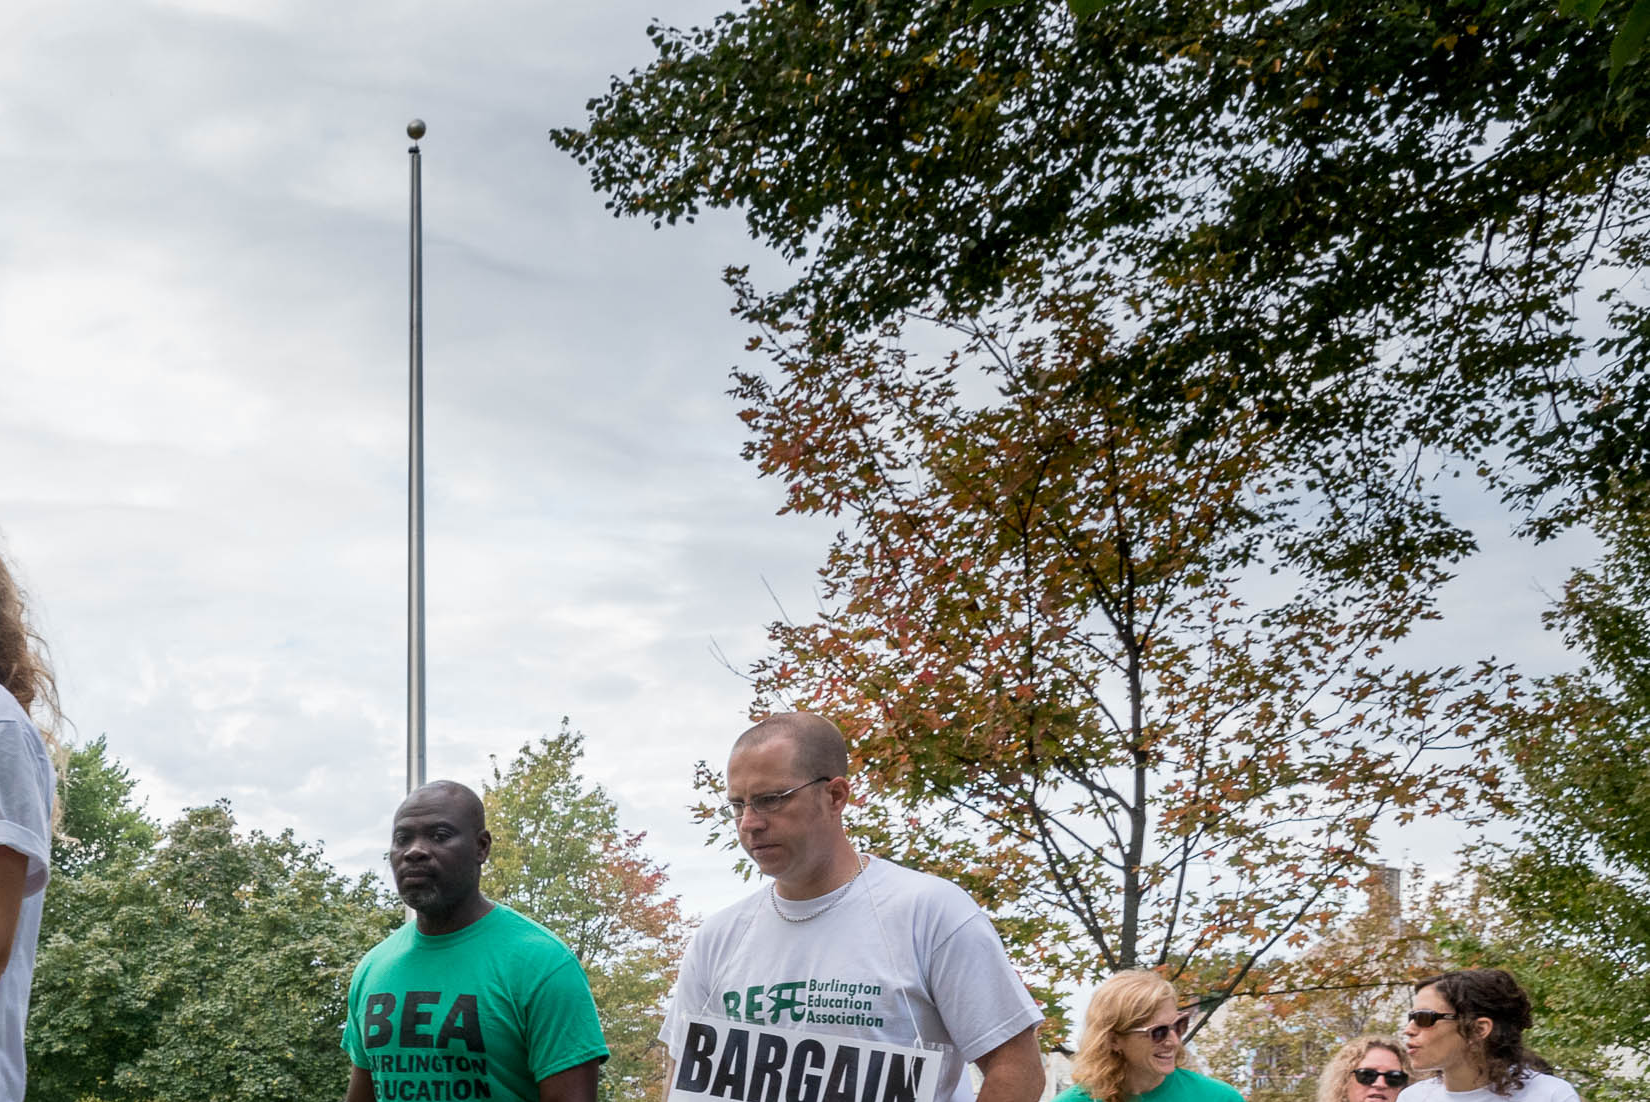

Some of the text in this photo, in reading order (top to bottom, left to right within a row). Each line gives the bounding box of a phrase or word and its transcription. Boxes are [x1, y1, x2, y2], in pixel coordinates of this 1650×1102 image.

[809, 978, 882, 997] Burlington
[807, 994, 872, 1011] Education
[364, 991, 487, 1054] BEA
[806, 1010, 884, 1028] Association
[373, 1078, 492, 1102] DUCATION
